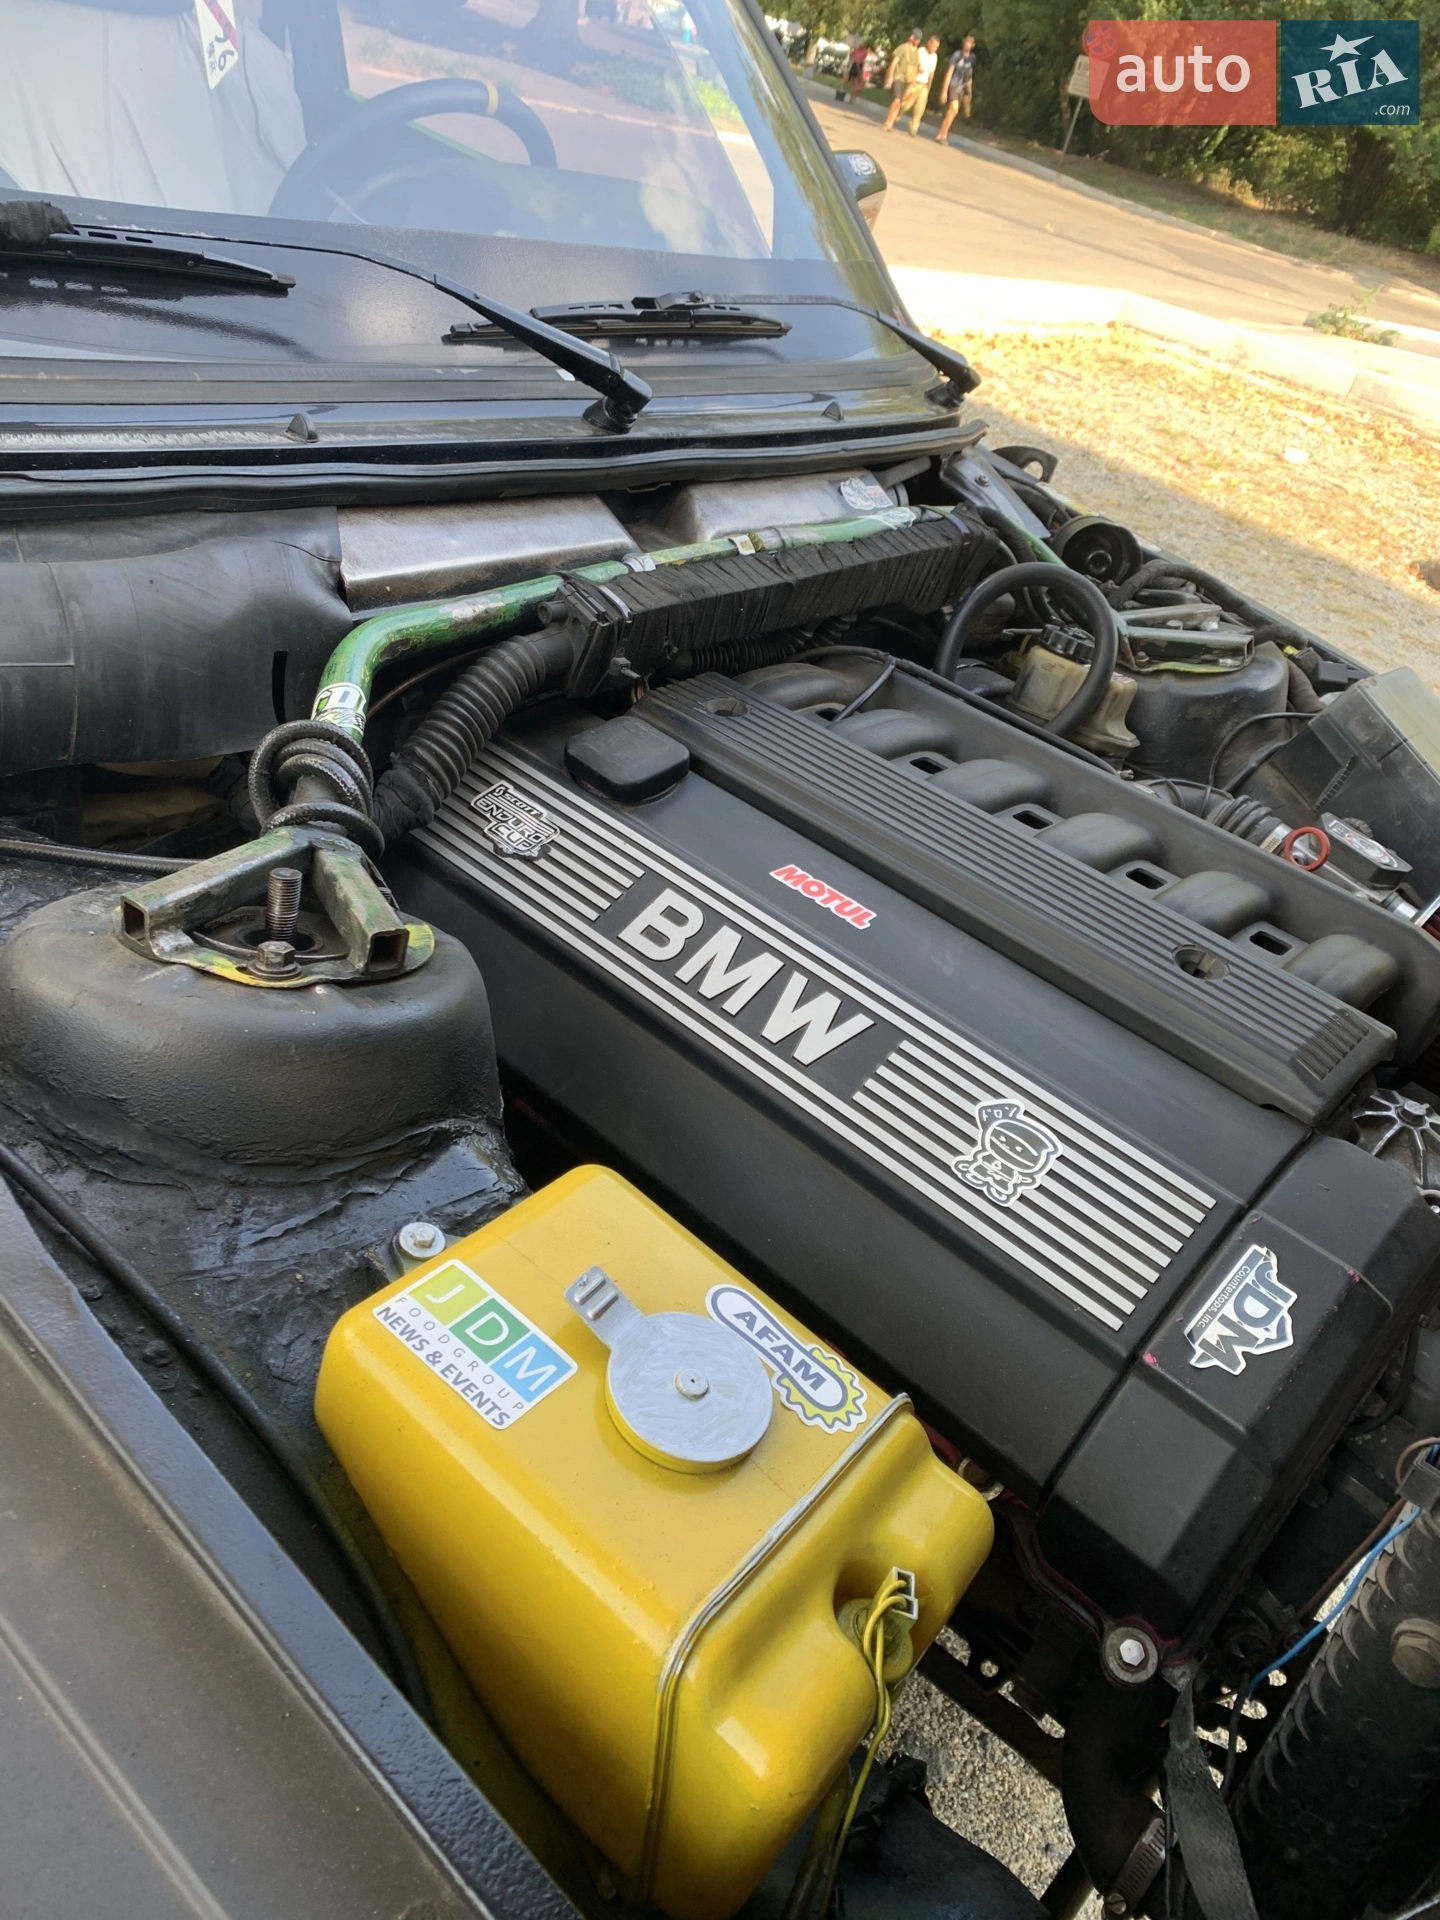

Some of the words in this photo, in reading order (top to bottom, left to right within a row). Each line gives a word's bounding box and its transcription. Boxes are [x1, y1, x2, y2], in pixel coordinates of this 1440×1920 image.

[477, 799, 547, 844] ENDURO
[502, 793, 540, 816] SCOTT
[493, 823, 533, 849] CUP
[771, 865, 875, 928] MOTUL
[617, 888, 877, 1067] BMW
[1208, 1265, 1251, 1313] Countertops,
[1196, 1315, 1213, 1328] Inc.
[1197, 1261, 1293, 1373] JDM
[376, 1306, 431, 1352] NEWS
[425, 1350, 443, 1367] &
[439, 1363, 511, 1427] EVENTS
[733, 1311, 827, 1392] AFAM
